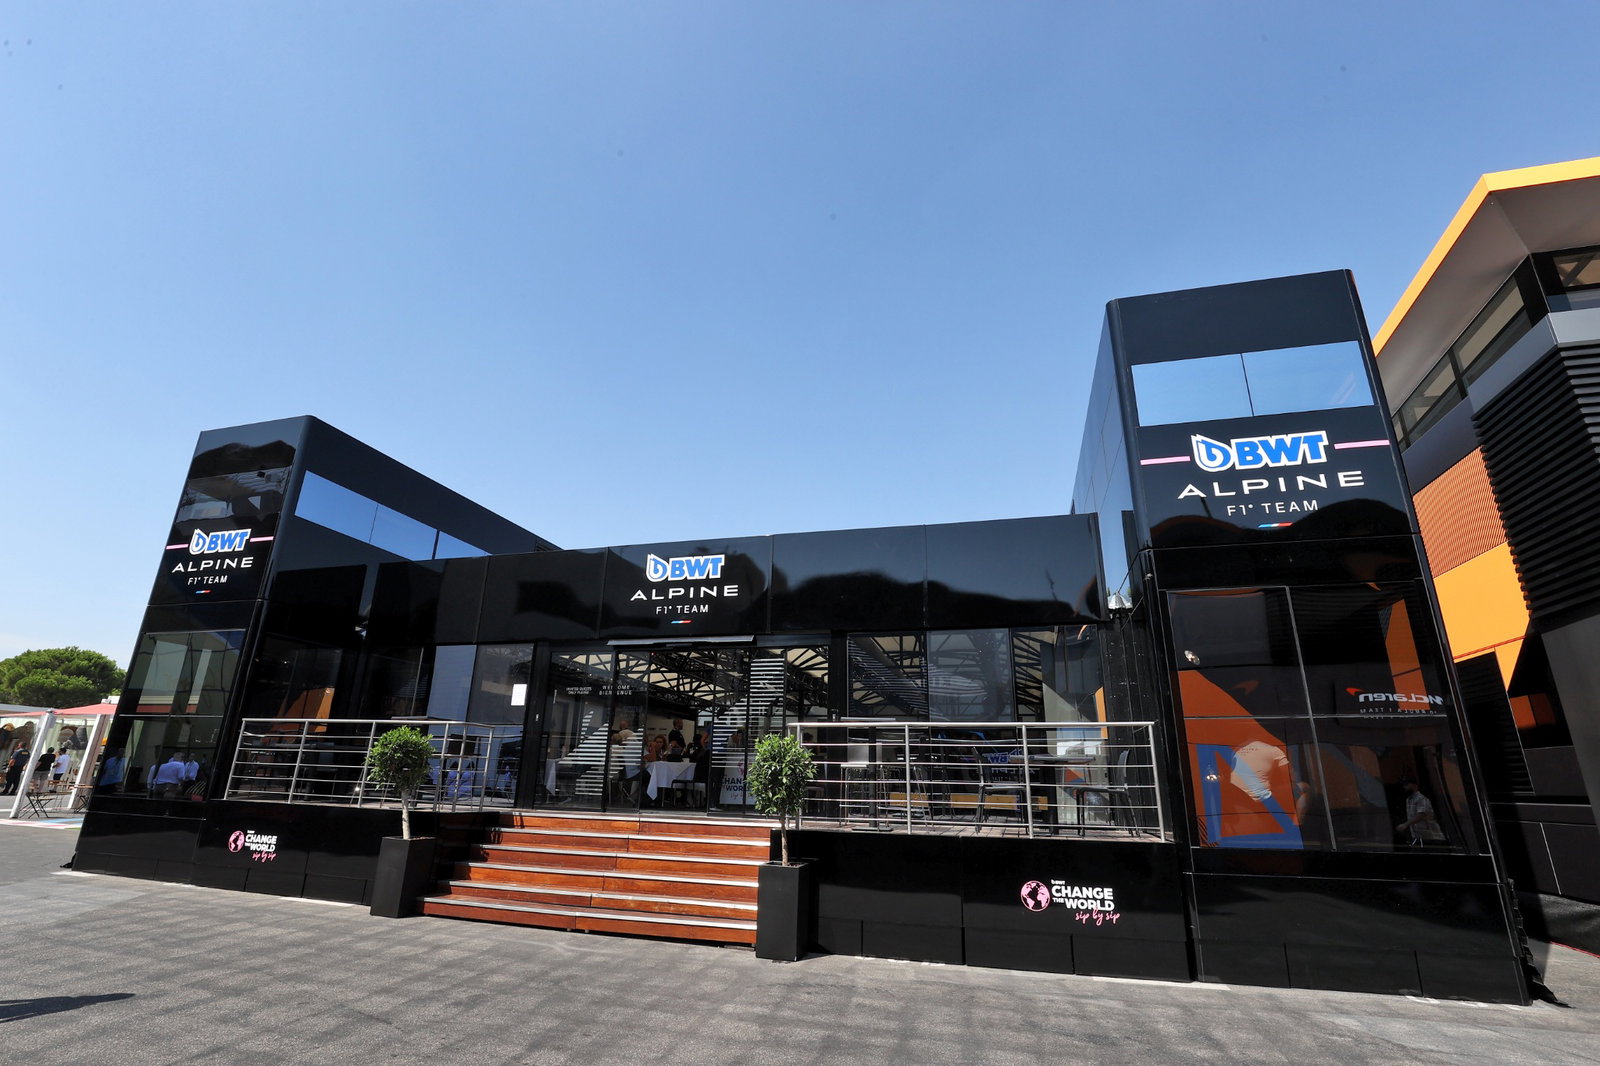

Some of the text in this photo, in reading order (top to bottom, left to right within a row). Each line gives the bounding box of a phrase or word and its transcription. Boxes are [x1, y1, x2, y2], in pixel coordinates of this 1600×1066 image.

[1230, 430, 1329, 470] BWT
[1177, 470, 1365, 499] ALPINE
[1261, 500, 1319, 514] TEAM
[204, 528, 252, 554] BWT
[172, 556, 254, 573] ALPINE
[668, 554, 725, 581] BWT
[203, 575, 228, 585] TEAM
[630, 584, 739, 601] ALPINE
[676, 604, 709, 614] TEAM
[245, 834, 278, 844] CHANGE
[250, 843, 276, 852] WORLD
[1051, 885, 1114, 900] CHANGE
[1065, 898, 1115, 911] WORLD
[1075, 907, 1121, 926] sip by sip
